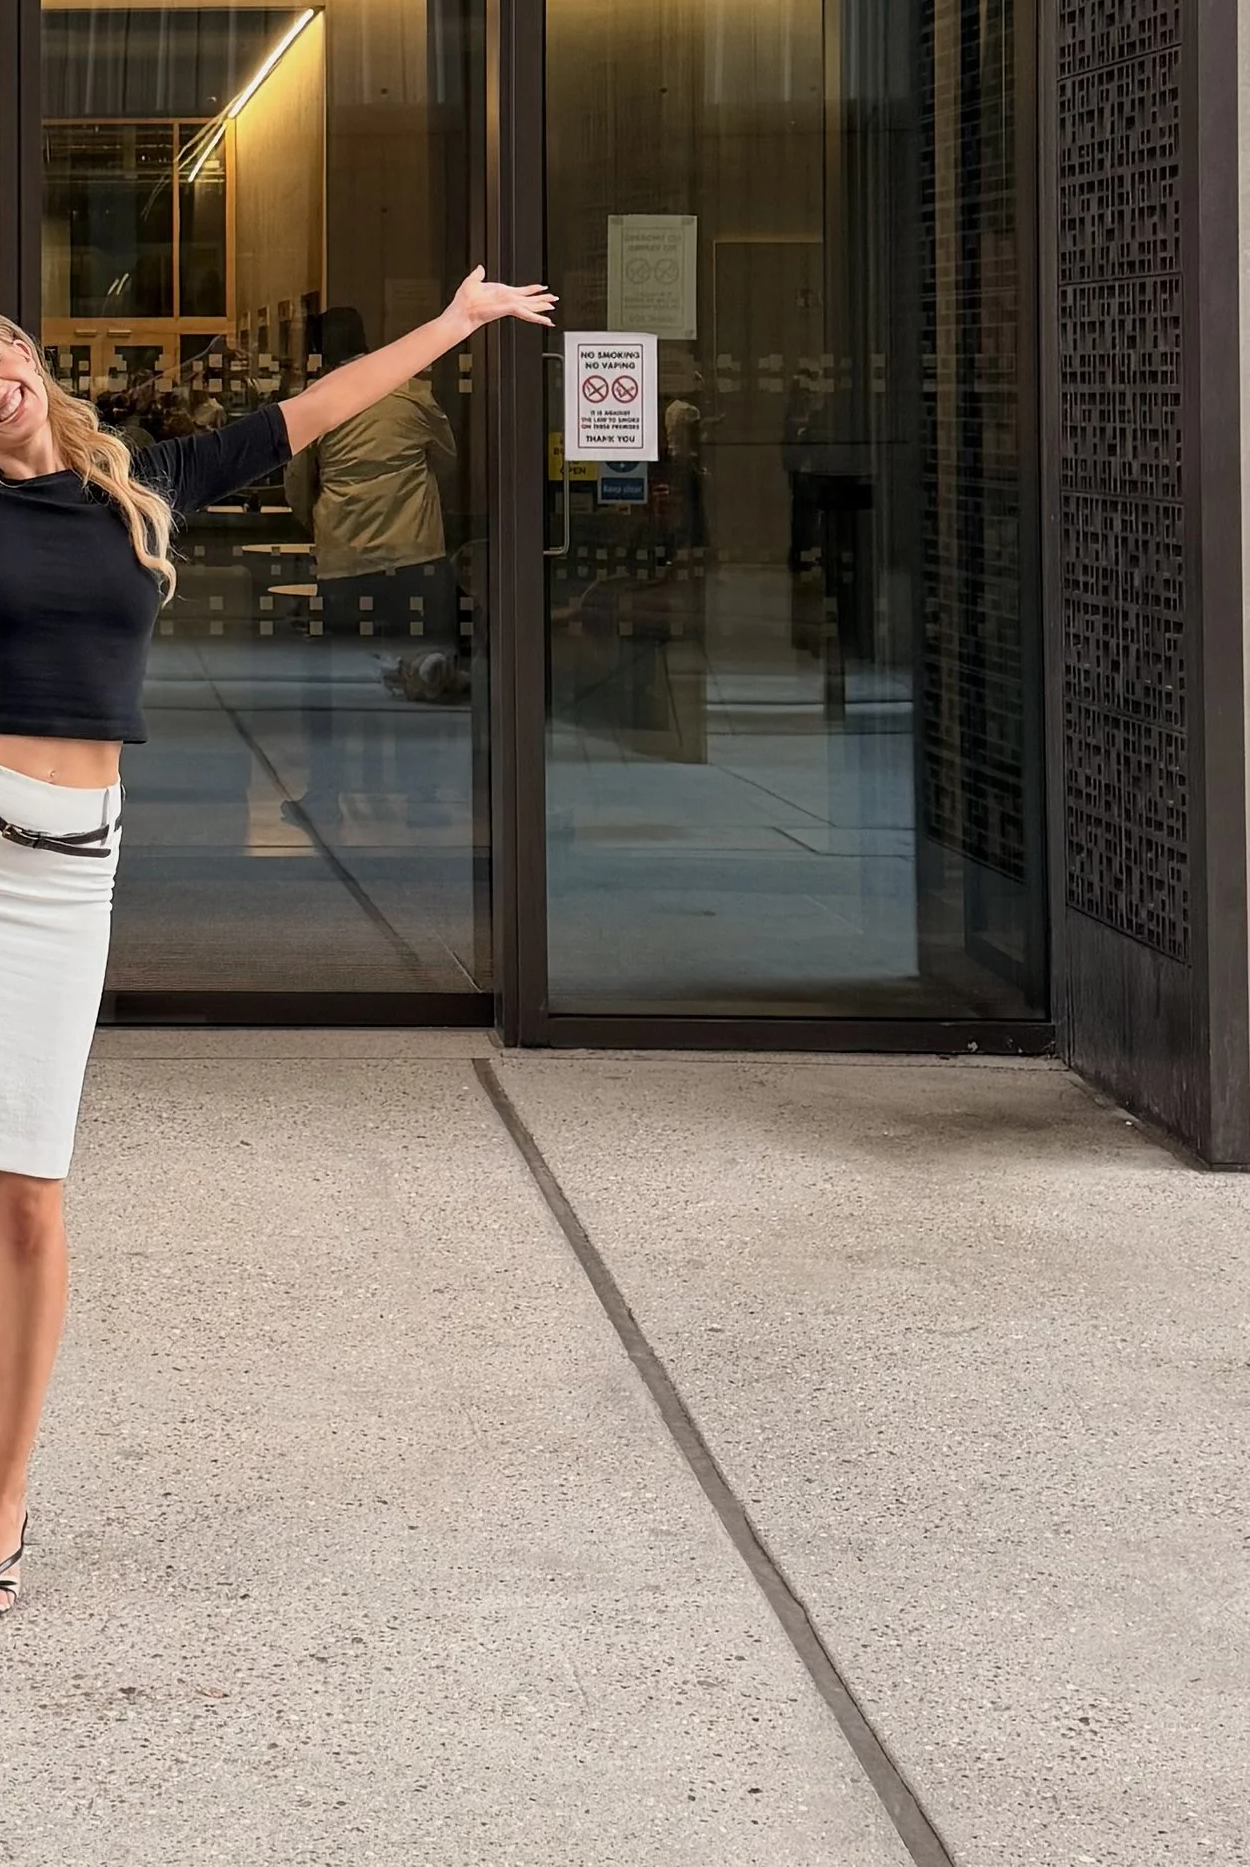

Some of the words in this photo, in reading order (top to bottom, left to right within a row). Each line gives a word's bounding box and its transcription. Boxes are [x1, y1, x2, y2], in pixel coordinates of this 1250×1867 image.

[580, 351, 595, 360] NO
[597, 351, 640, 360] SMOKING
[585, 362, 600, 370] NO
[602, 362, 636, 370] VAPING
[586, 435, 615, 443] THANK
[617, 435, 636, 443] YOU
